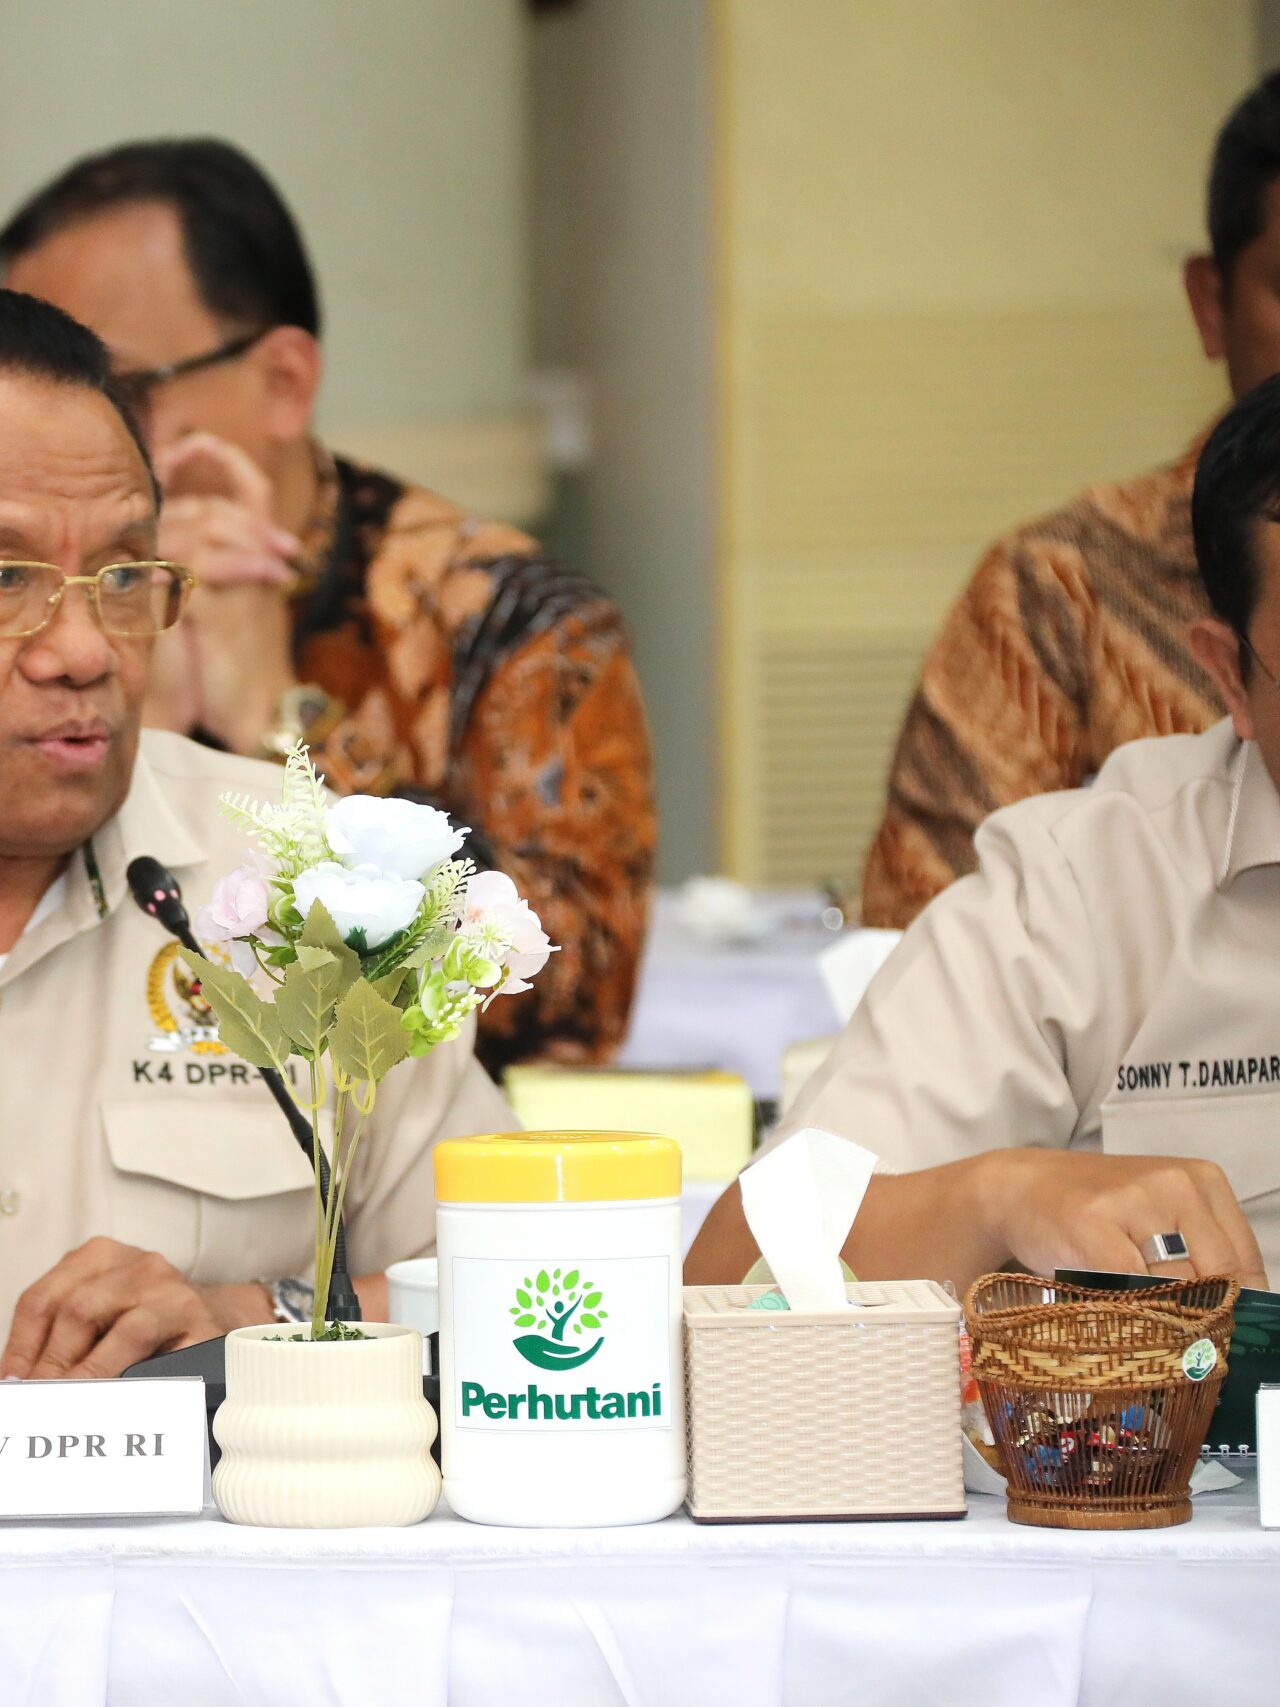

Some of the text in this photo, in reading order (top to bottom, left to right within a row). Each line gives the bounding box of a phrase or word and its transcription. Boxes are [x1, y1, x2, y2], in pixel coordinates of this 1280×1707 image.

[132, 1060, 174, 1083] K4
[1117, 1062, 1172, 1090] SONNY
[461, 1381, 662, 1420] Perhutani
[26, 1434, 108, 1460] DPR
[123, 1433, 165, 1457] RI
